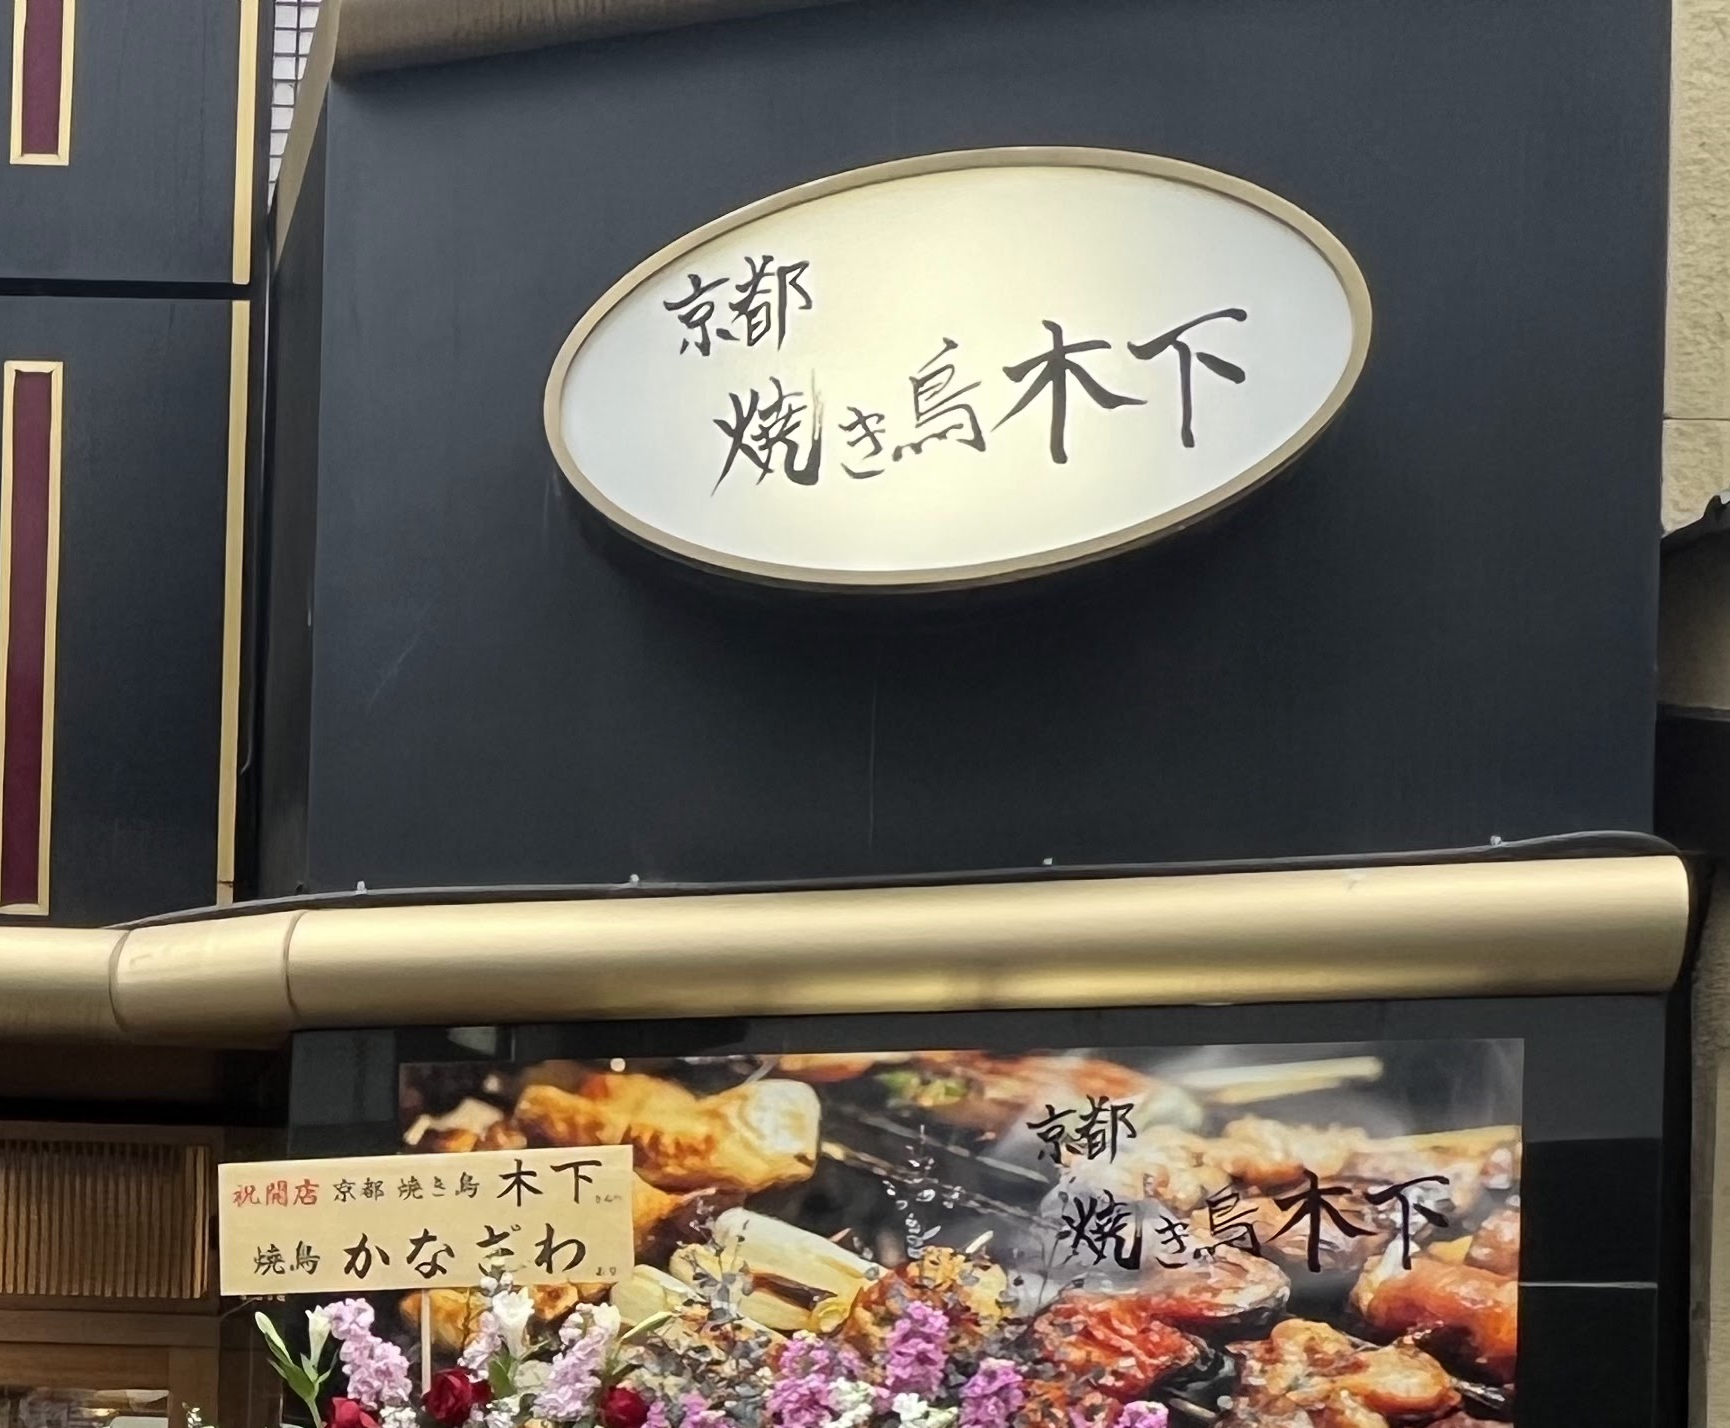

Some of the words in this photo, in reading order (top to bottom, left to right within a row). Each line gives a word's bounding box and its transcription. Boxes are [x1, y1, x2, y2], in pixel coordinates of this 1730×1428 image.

[662, 253, 814, 357] 京都
[710, 308, 1249, 497] 焼き鳥木下
[1025, 1093, 1138, 1165] 京都
[231, 1178, 321, 1208] 祝開店
[333, 1178, 386, 1203] 京都
[396, 1170, 482, 1203] 焼き鳥
[496, 1157, 604, 1208] 木下
[253, 1240, 322, 1277] 焼鳥
[342, 1222, 588, 1281] かなざわ
